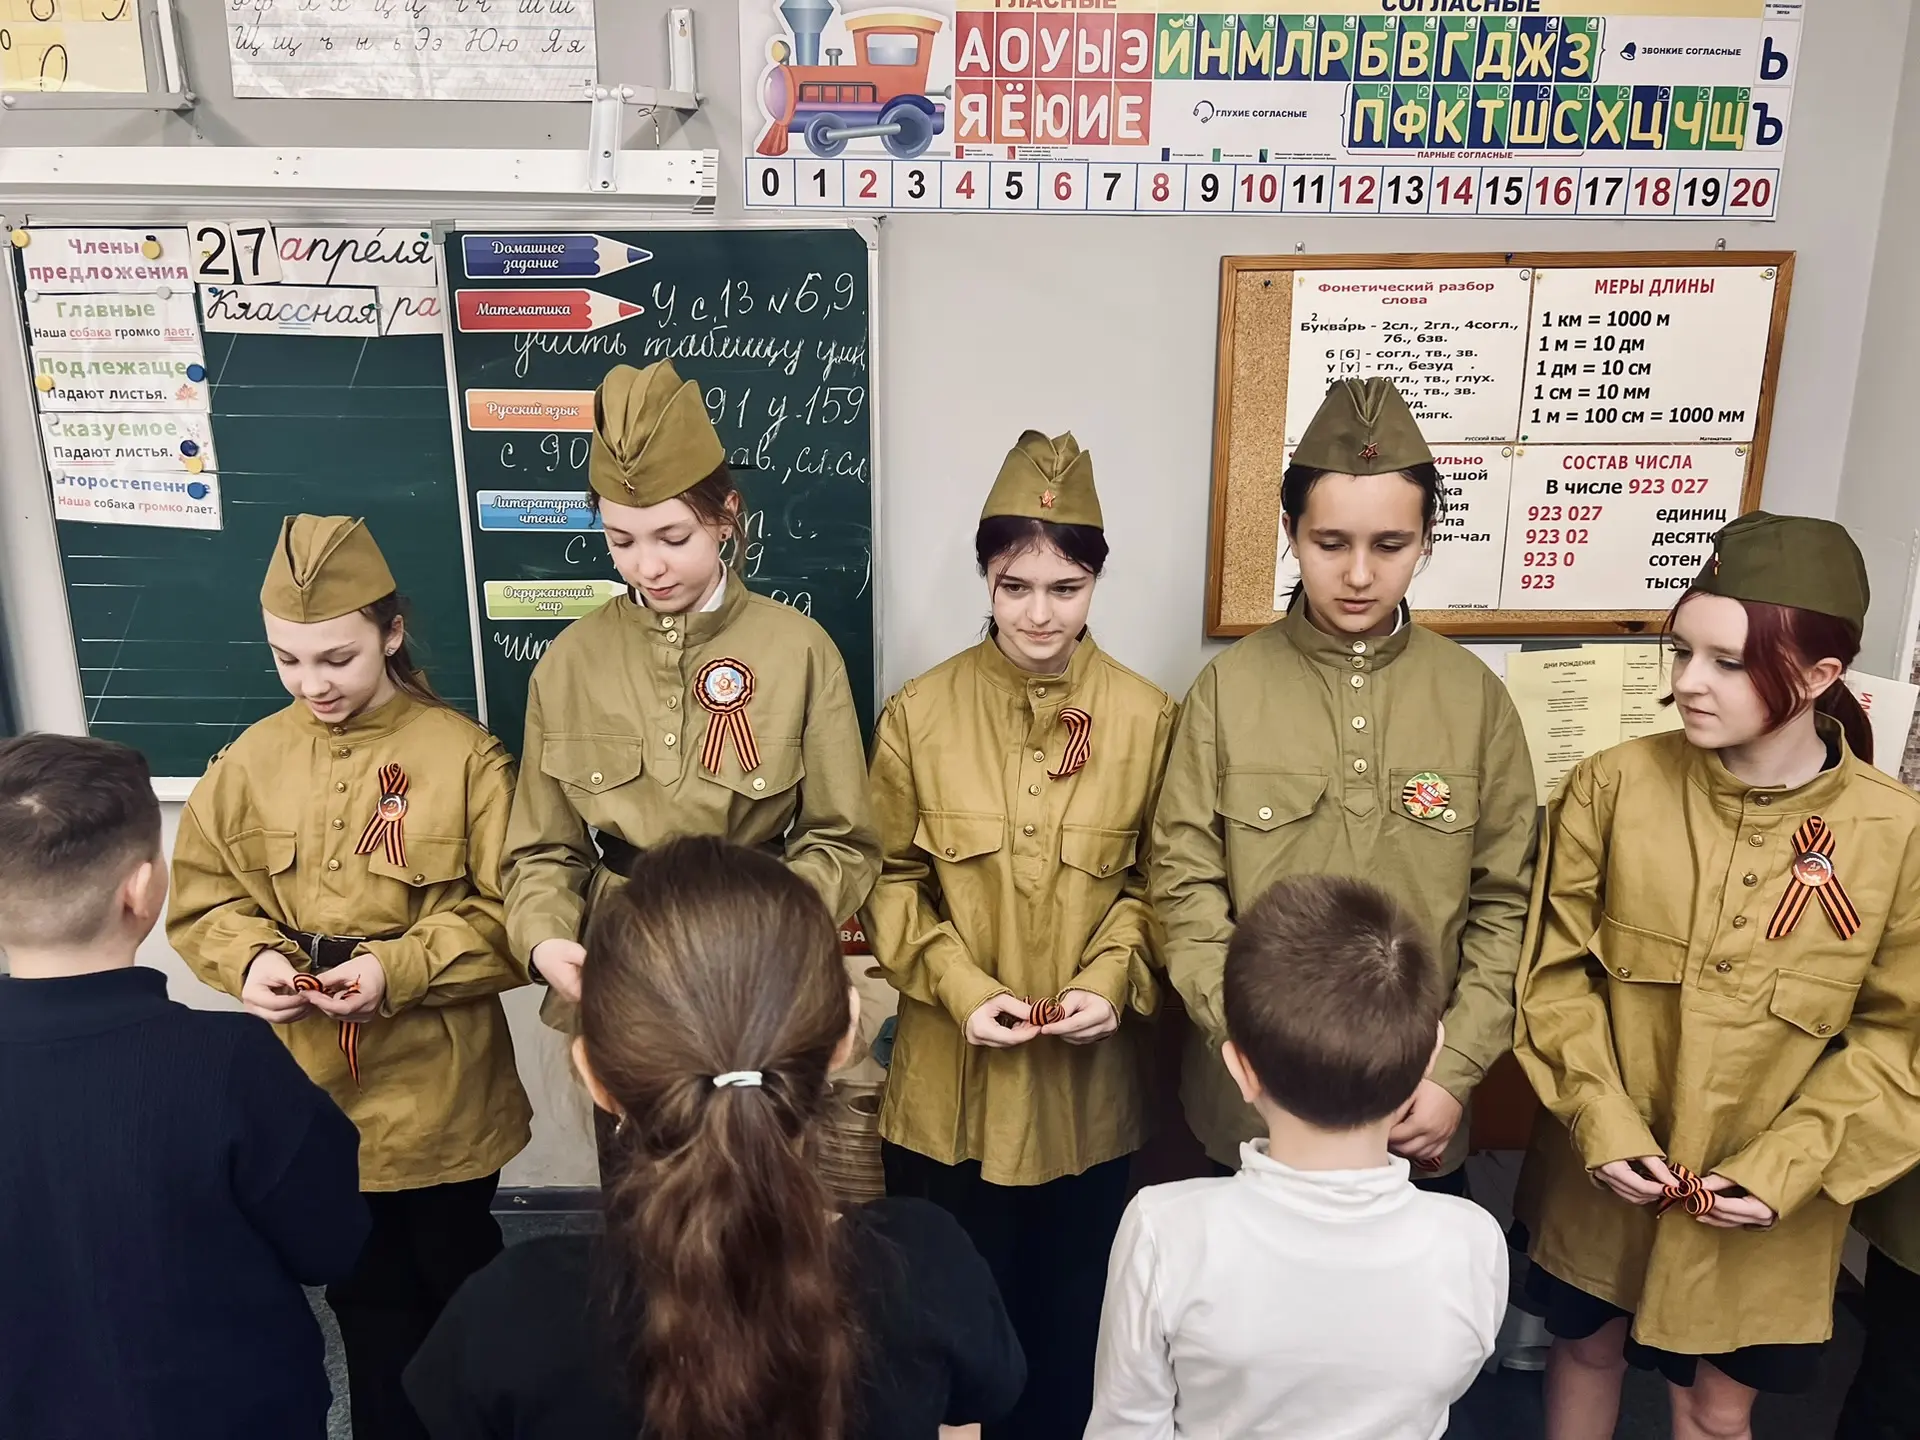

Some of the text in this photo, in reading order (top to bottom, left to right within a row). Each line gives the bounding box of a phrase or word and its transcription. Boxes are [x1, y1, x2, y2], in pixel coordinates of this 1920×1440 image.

[1641, 47, 1742, 56] ЗВОНКИЕ СОГЛАСНЫЕ
[1216, 109, 1307, 118] ГЛУХИЕ СОГЛАСНЫЕ
[762, 168, 1771, 207] 0 1 2 3 4 5 6 7 8 9 10 11 12 13 14 15 16 17 18 19 20
[68, 239, 139, 254] Члены
[492, 240, 565, 255] Домашнее
[503, 258, 559, 274] задание
[29, 266, 188, 283] предложения
[1318, 282, 1494, 293] Фонетический разбор
[1595, 278, 1715, 296] МЕРЫ ДЛИНЫ
[207, 289, 376, 324] Классная
[1382, 296, 1427, 305] слова
[56, 302, 156, 318] Главные
[476, 303, 571, 316] Математика
[1382, 321, 1418, 332] 2сл.,
[1424, 321, 1460, 332] 2гл.,
[1465, 320, 1518, 331] 4согл.,
[1542, 311, 1670, 327] 1 км 1000 м
[34, 328, 195, 339] Наша собака громко лает.
[1539, 336, 1645, 353] 1 м 10 дм
[1376, 349, 1420, 360] согл.,
[1425, 350, 1451, 359] тв.,
[1456, 350, 1478, 358] зв.
[38, 357, 187, 379] Подлежаще
[1377, 363, 1403, 373] гл.,
[1536, 360, 1651, 378] 1 дм 10 см
[1424, 375, 1495, 385] тв., глух.
[47, 389, 167, 401] Падают листья.
[1423, 388, 1476, 398] тв., зв.
[1534, 384, 1650, 400] 1 см 10 мм
[486, 401, 579, 420] Русский язык
[1416, 411, 1453, 419] мягк.
[1531, 407, 1744, 423] 1 м 100 см 1000 мм
[49, 422, 178, 440] Сказуемое
[53, 447, 173, 460] Падают листья.
[1563, 455, 1692, 470] СОСТАВ ЧИСЛА
[56, 475, 211, 493] торостепенне
[1546, 479, 1709, 494] В числе 923 027
[58, 496, 217, 515] Наша собака громко лает.
[519, 513, 567, 524] чтение
[1528, 506, 1727, 523] 923 027 единиц
[1433, 533, 1490, 543] ри-чал
[1526, 529, 1716, 546] 923 02 десятк
[1523, 552, 1702, 567] 923 0 сотен
[1521, 575, 1556, 589] 923
[503, 586, 593, 603] Окружающий
[536, 602, 562, 615] мир
[1543, 661, 1558, 669] ДНИ
[840, 930, 866, 942] ВА
